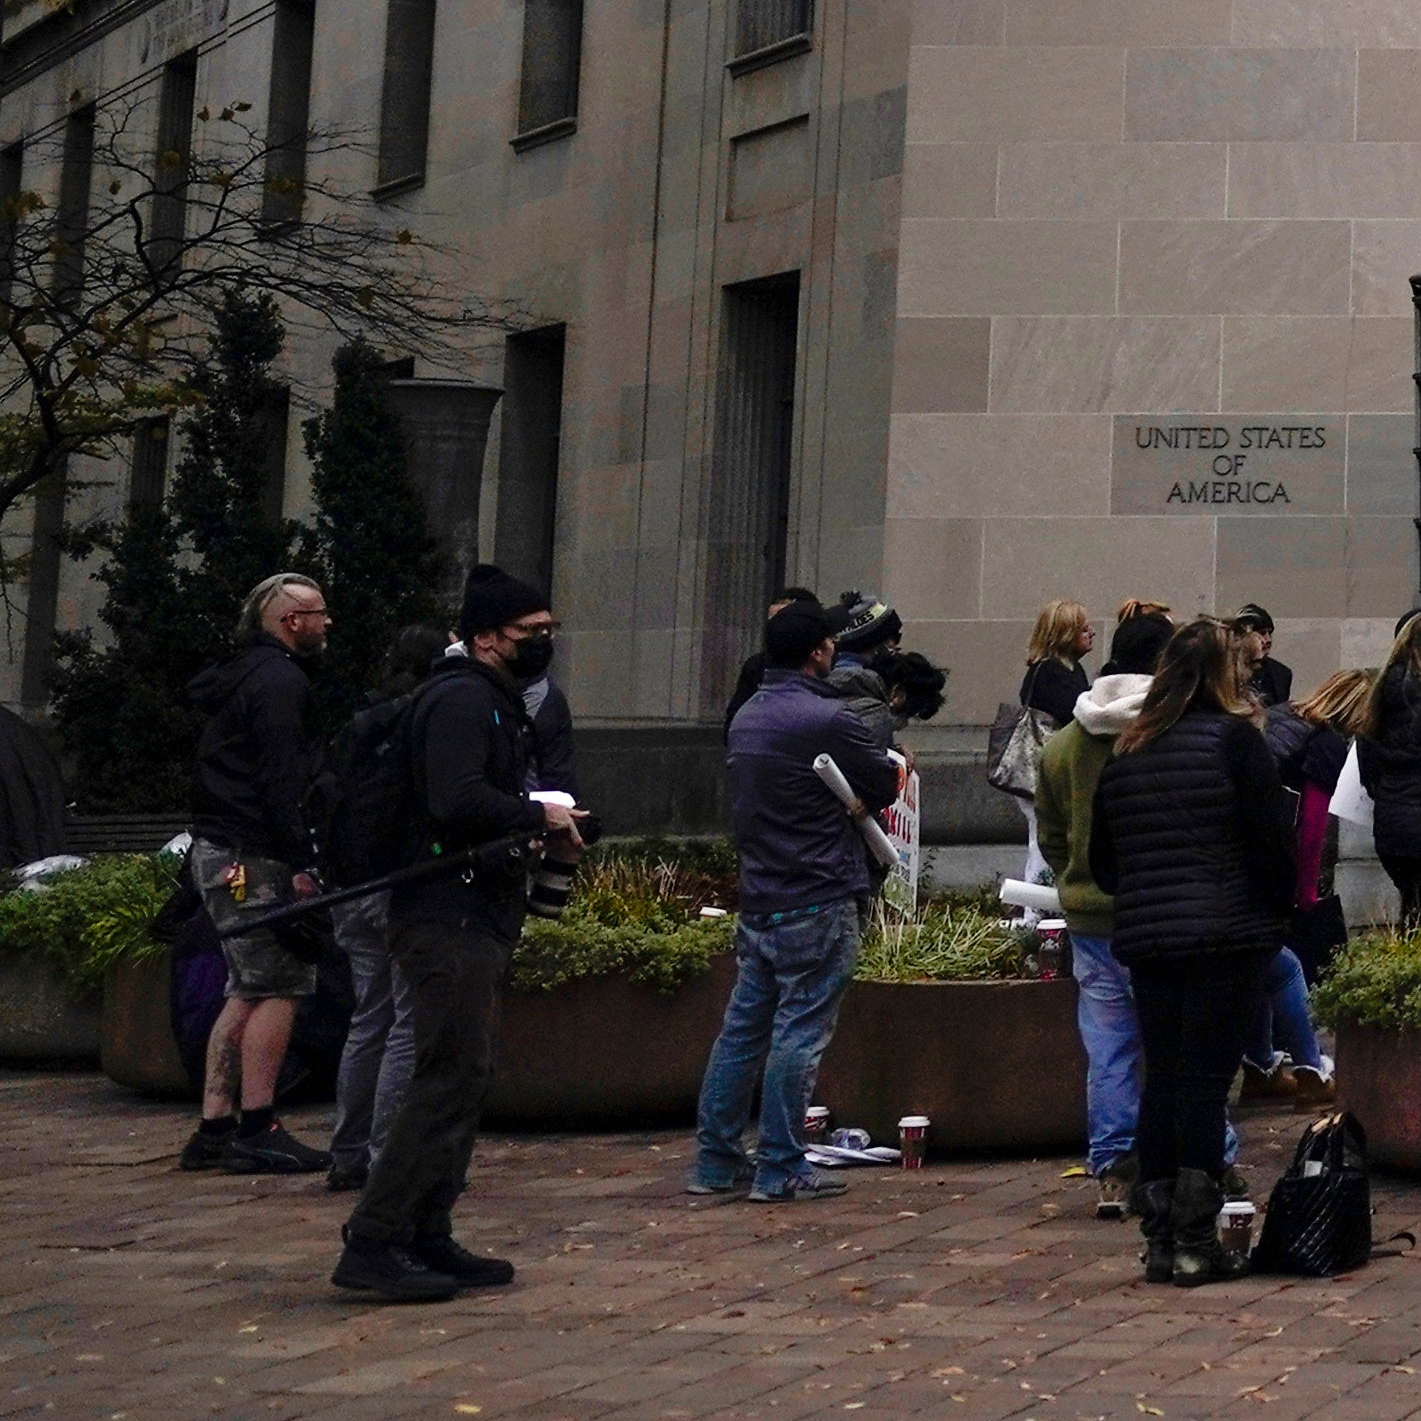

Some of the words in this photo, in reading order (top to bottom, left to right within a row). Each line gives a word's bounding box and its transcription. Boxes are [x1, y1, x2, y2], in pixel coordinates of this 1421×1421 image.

[1135, 426, 1230, 449] UNITED
[1239, 426, 1326, 449] STATES
[1212, 455, 1247, 476] OF
[1166, 482, 1291, 503] AMERICA
